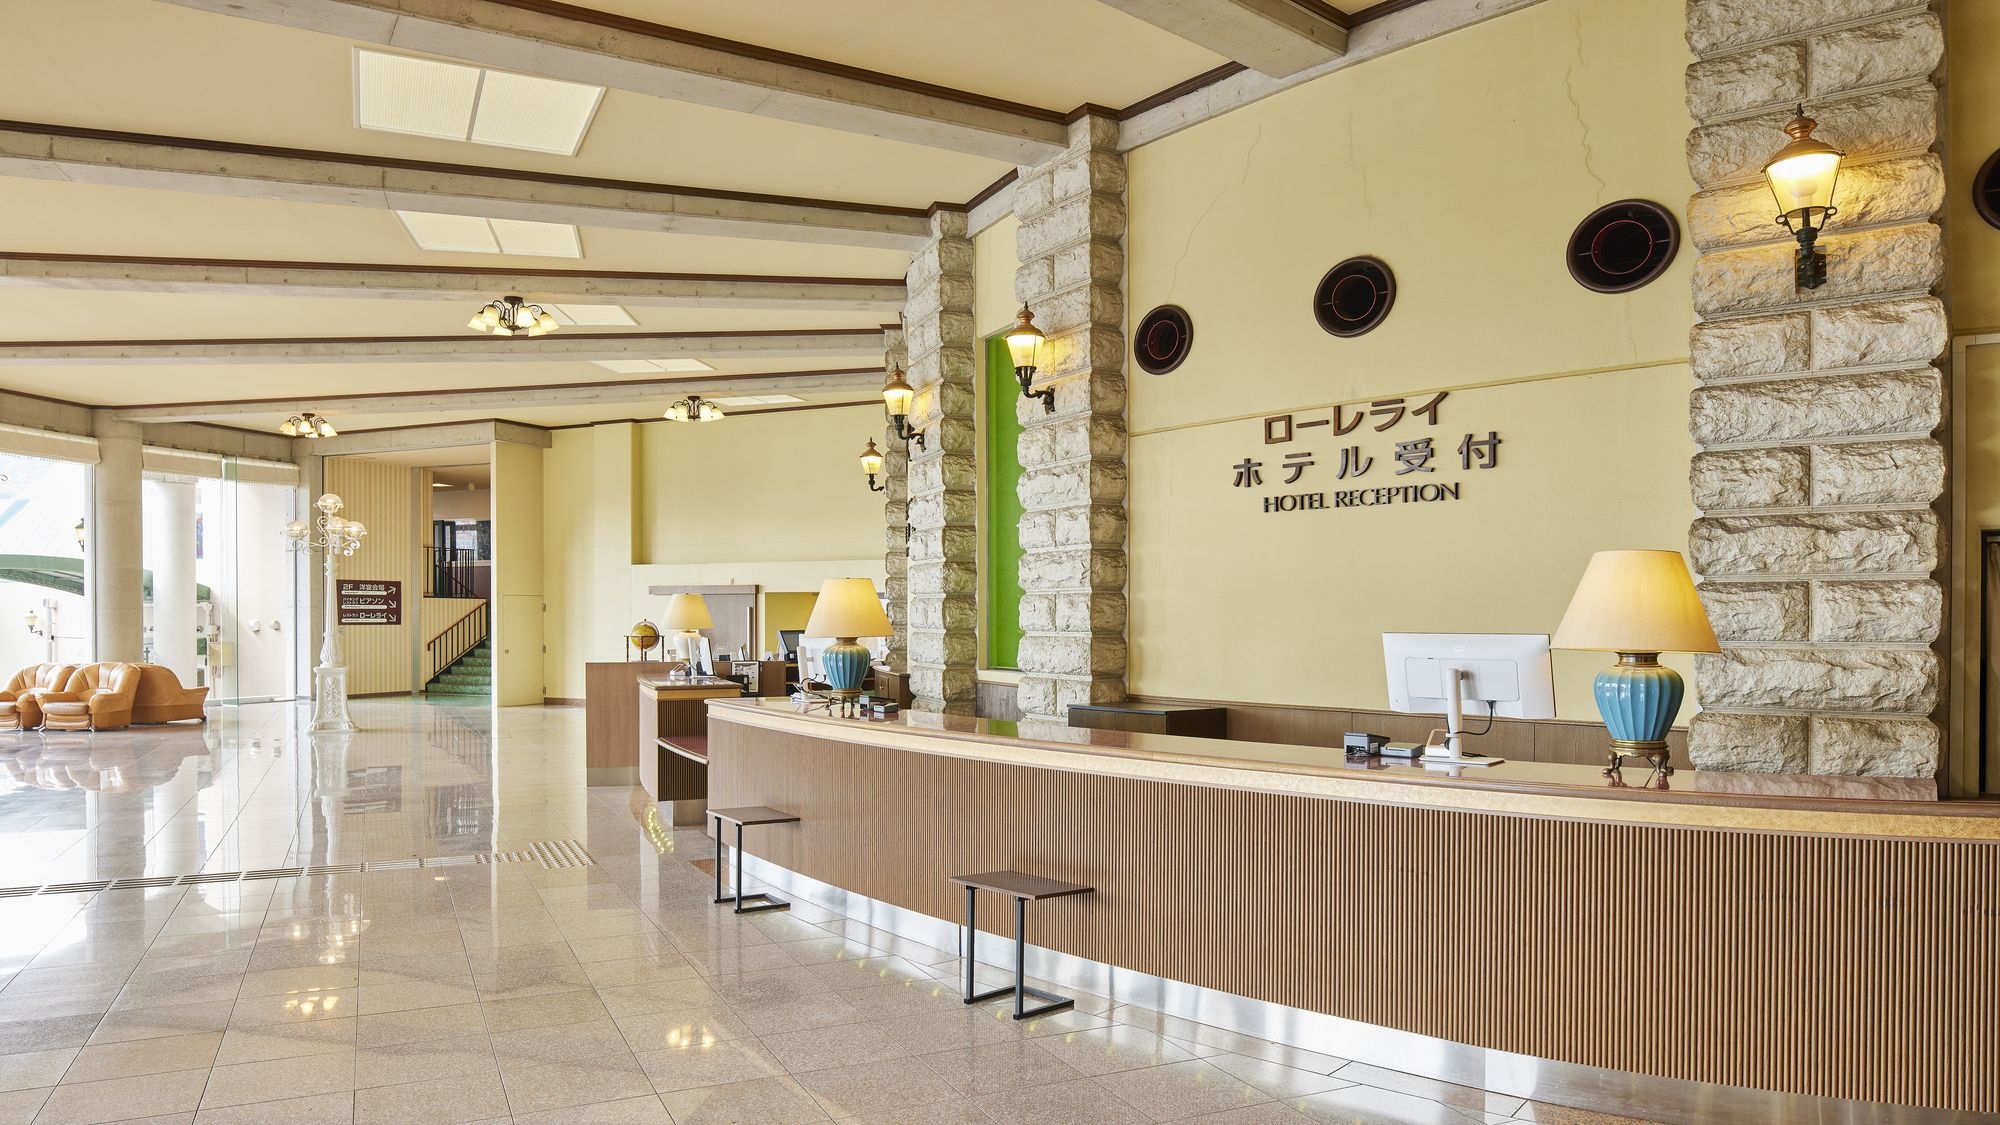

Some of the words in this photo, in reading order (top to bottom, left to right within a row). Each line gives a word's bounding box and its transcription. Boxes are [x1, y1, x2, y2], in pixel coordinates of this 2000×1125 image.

[1264, 391, 1449, 444] ローレライ
[1232, 431, 1502, 487] ホテル受付
[1263, 492, 1330, 513] HOTEL
[1334, 482, 1459, 508] RECEPTION
